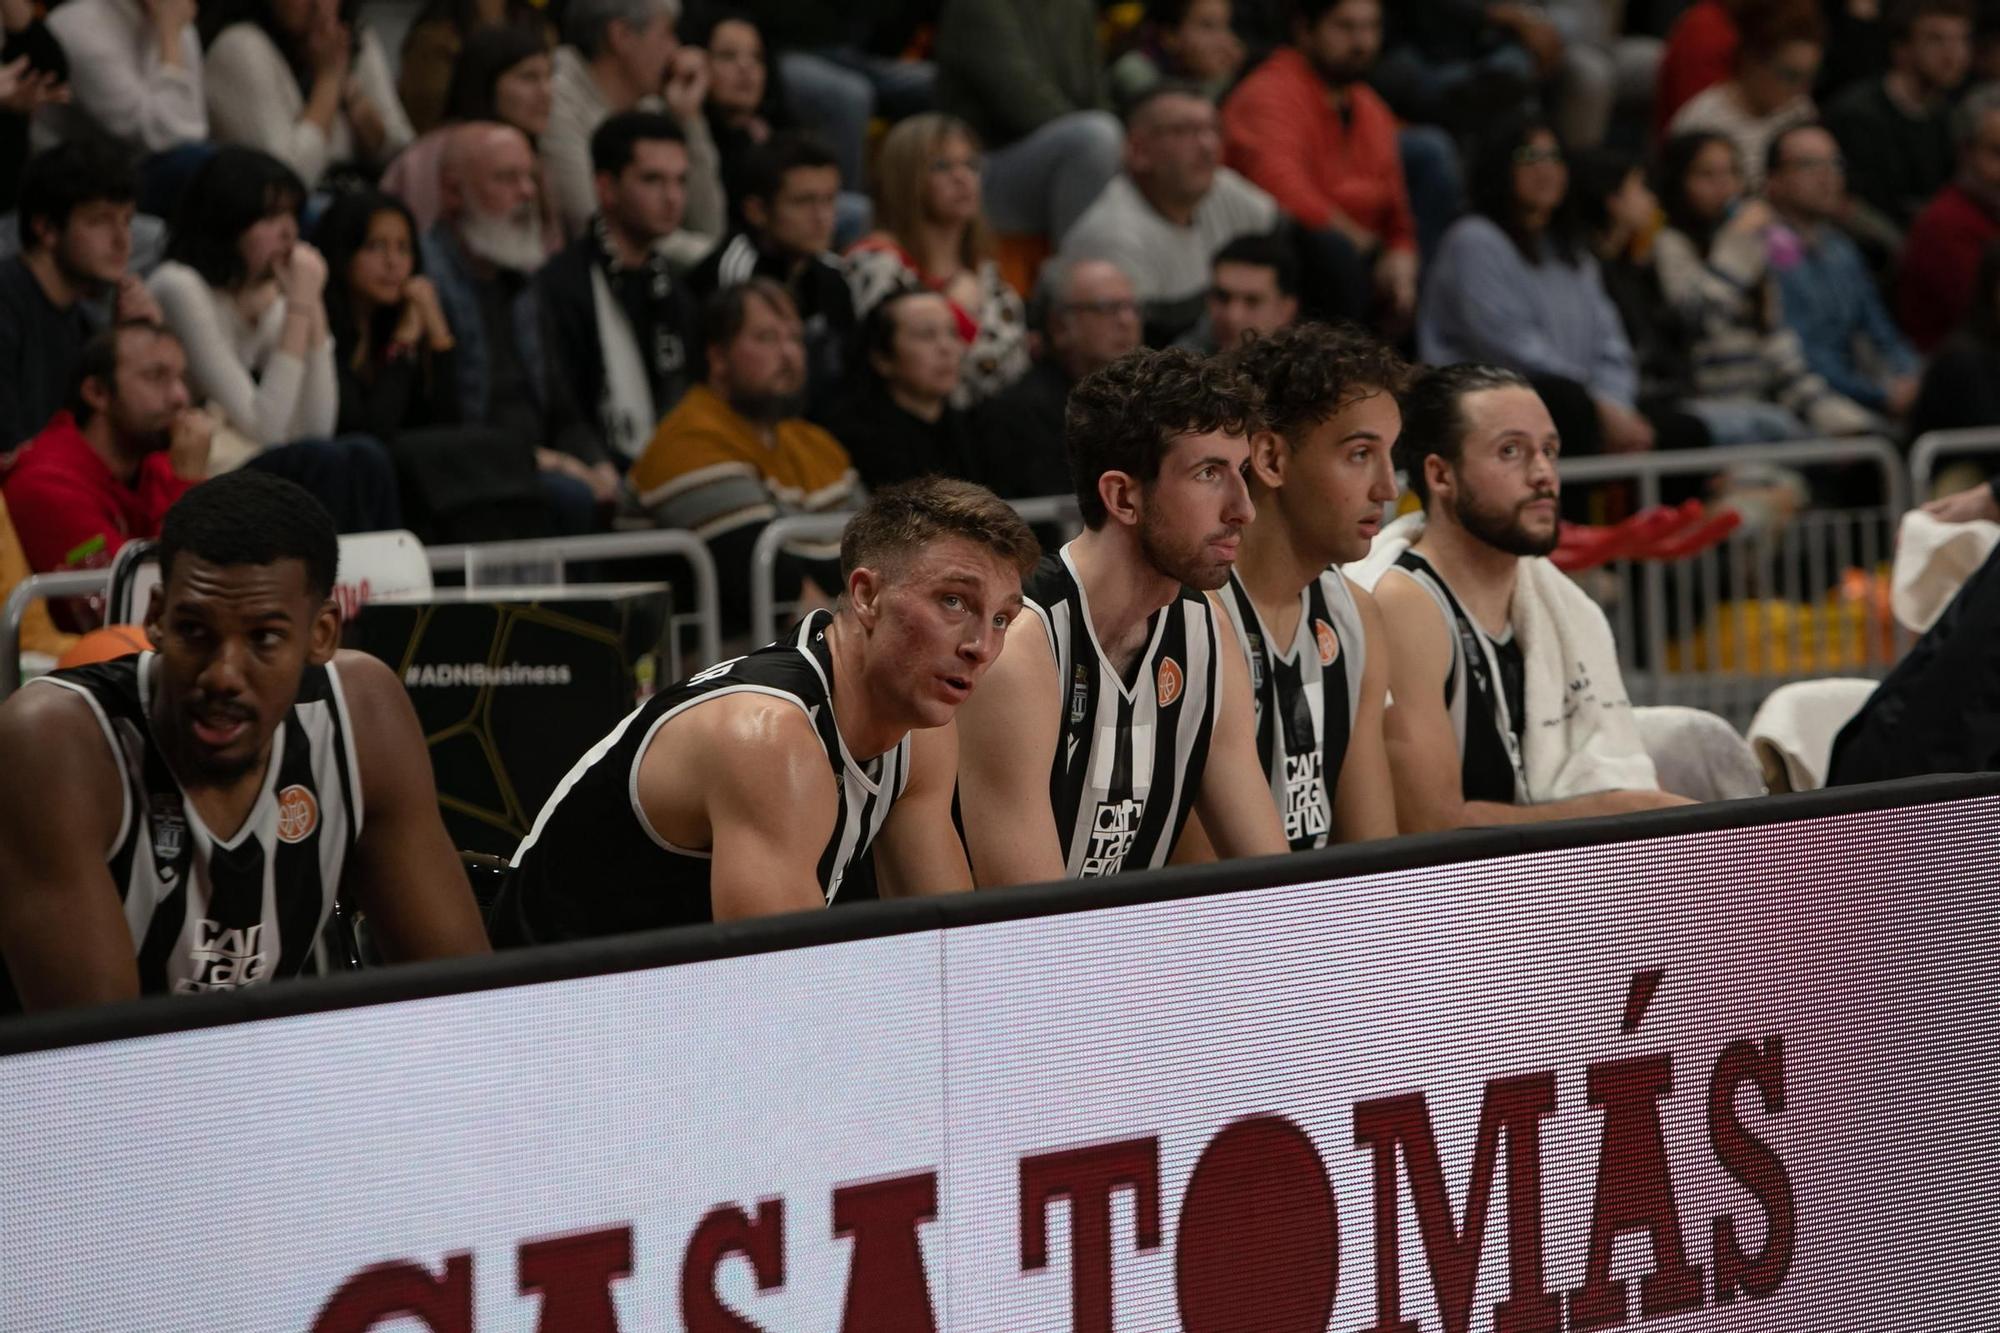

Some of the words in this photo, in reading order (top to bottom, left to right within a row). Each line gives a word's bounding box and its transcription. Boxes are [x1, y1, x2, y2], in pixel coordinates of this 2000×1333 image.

[404, 661, 571, 687] #ADNBusiness
[306, 1165, 937, 1333] SA
[1019, 968, 1797, 1333] TOMÁS
